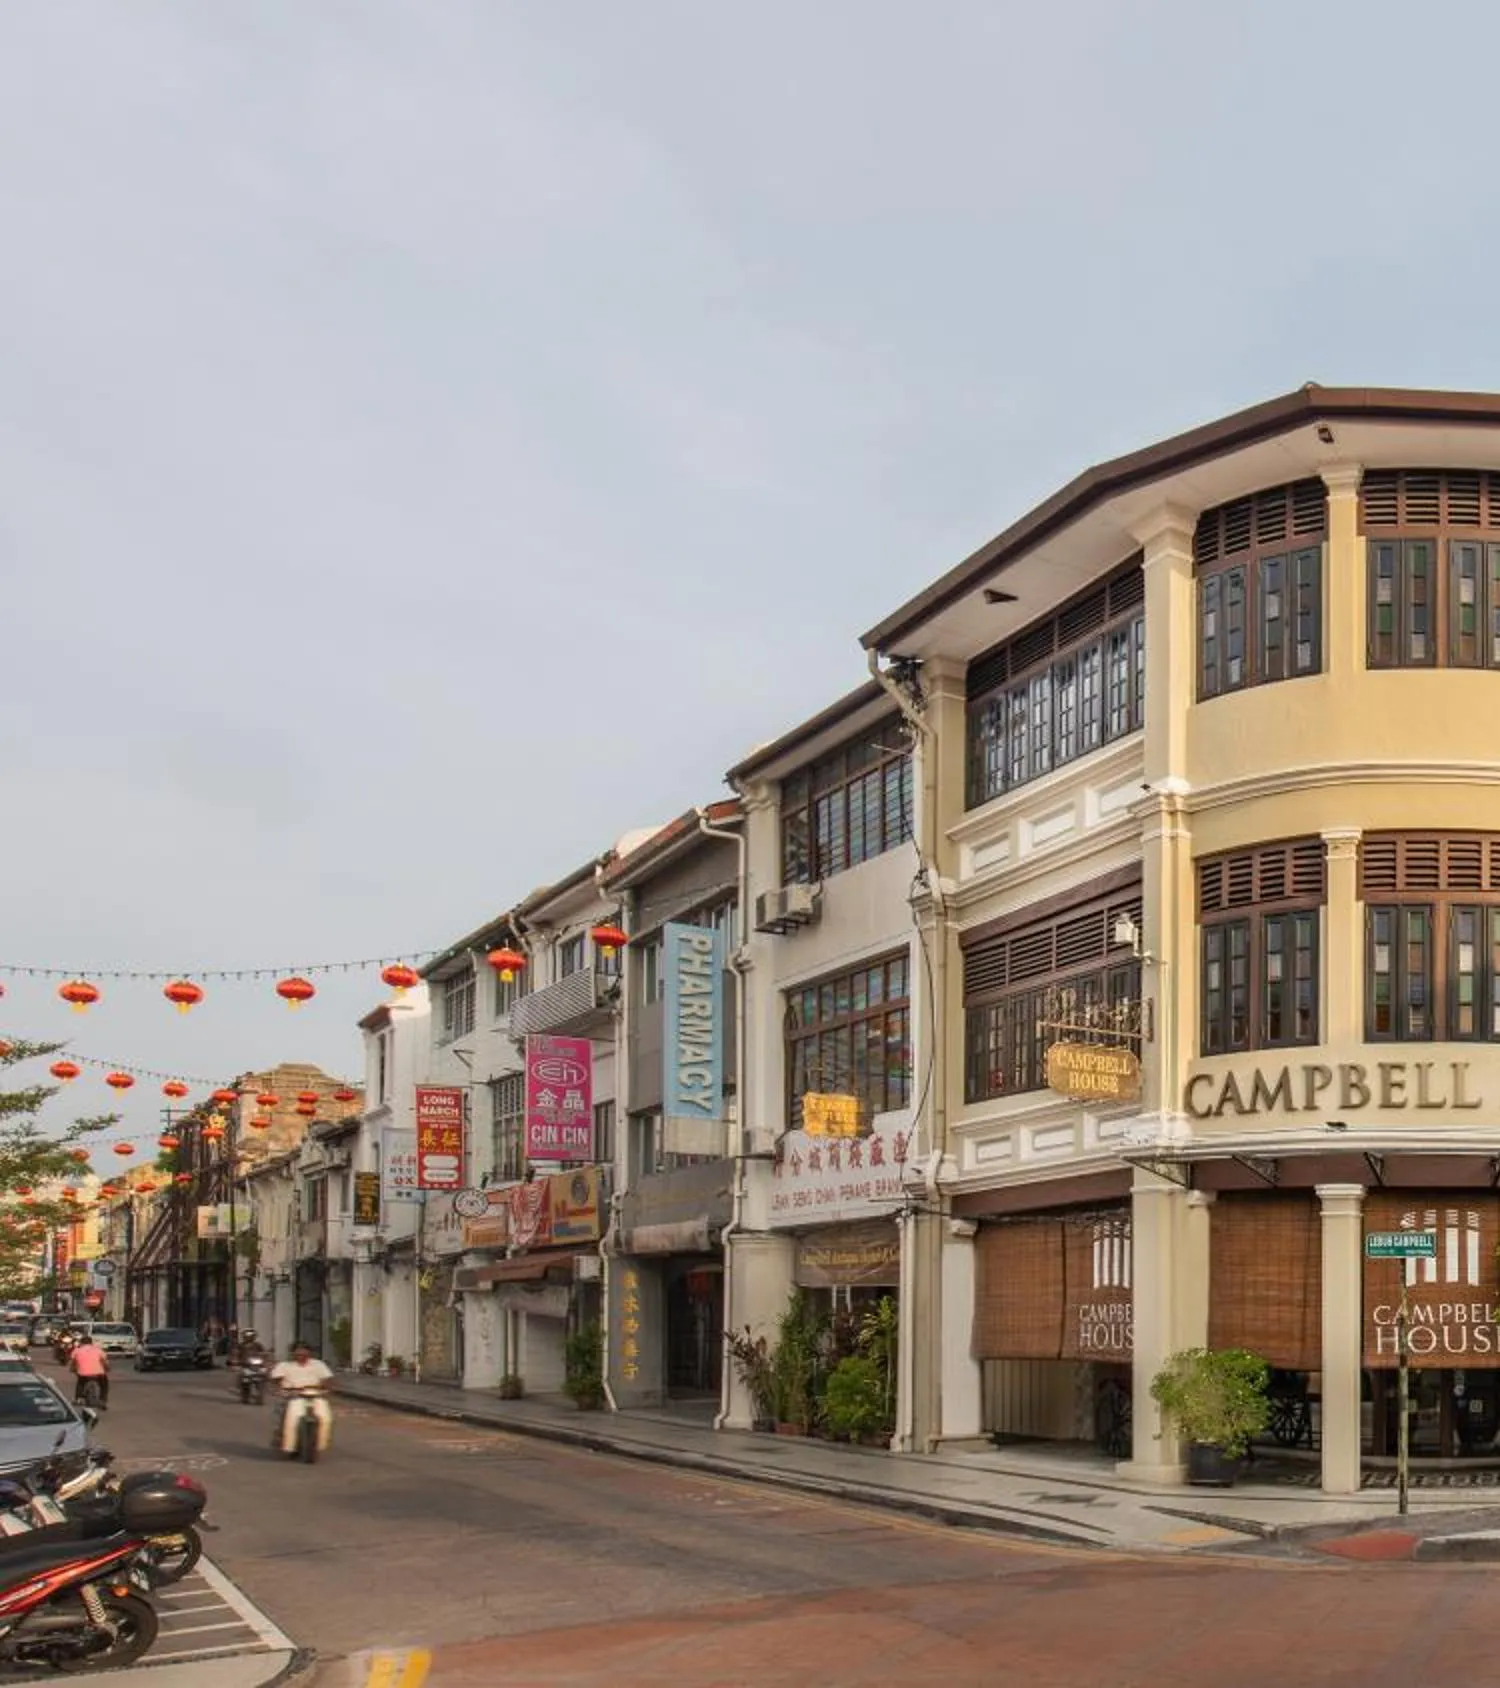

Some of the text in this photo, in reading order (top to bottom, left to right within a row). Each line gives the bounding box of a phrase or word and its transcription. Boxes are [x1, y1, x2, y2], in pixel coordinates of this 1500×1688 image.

[678, 932, 713, 1113] PHARMACY
[1055, 1049, 1131, 1075] CAMPBELL
[1069, 1071, 1119, 1093] HOUSE
[1184, 1062, 1482, 1119] CAMPBELL
[419, 1105, 459, 1117] MARCH
[423, 1095, 455, 1106] LONG
[531, 1124, 589, 1145] CIN CIN
[1394, 1235, 1432, 1248] CAMPBELL
[1079, 1303, 1133, 1323] CAMPBE
[1079, 1323, 1134, 1349] HOUS
